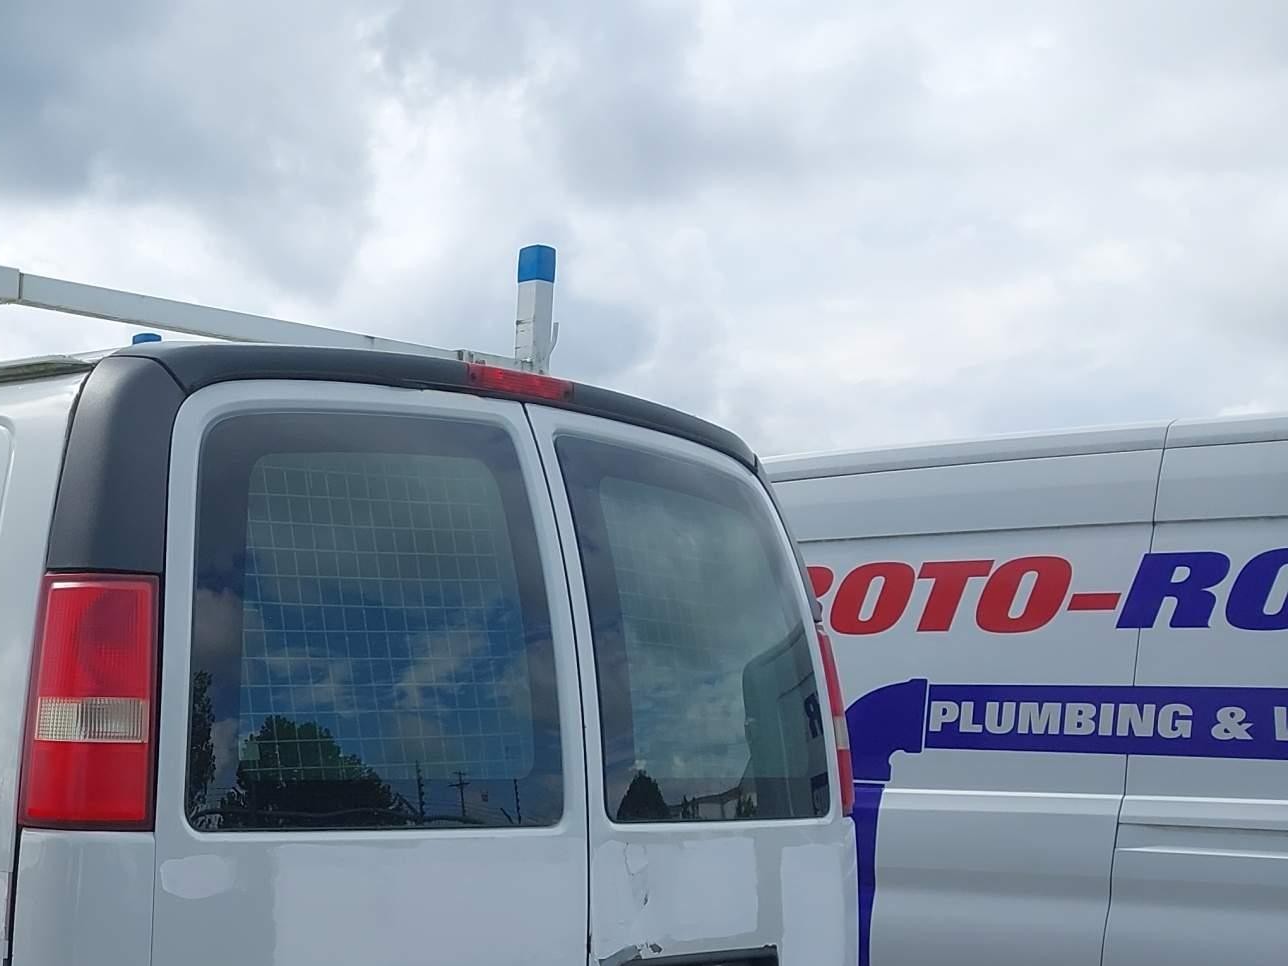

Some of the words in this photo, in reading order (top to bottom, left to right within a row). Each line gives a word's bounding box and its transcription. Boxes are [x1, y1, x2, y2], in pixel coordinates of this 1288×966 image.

[805, 547, 1288, 636] OTO-RO
[928, 700, 1193, 739] PLUMBING
[1211, 706, 1254, 741] &
